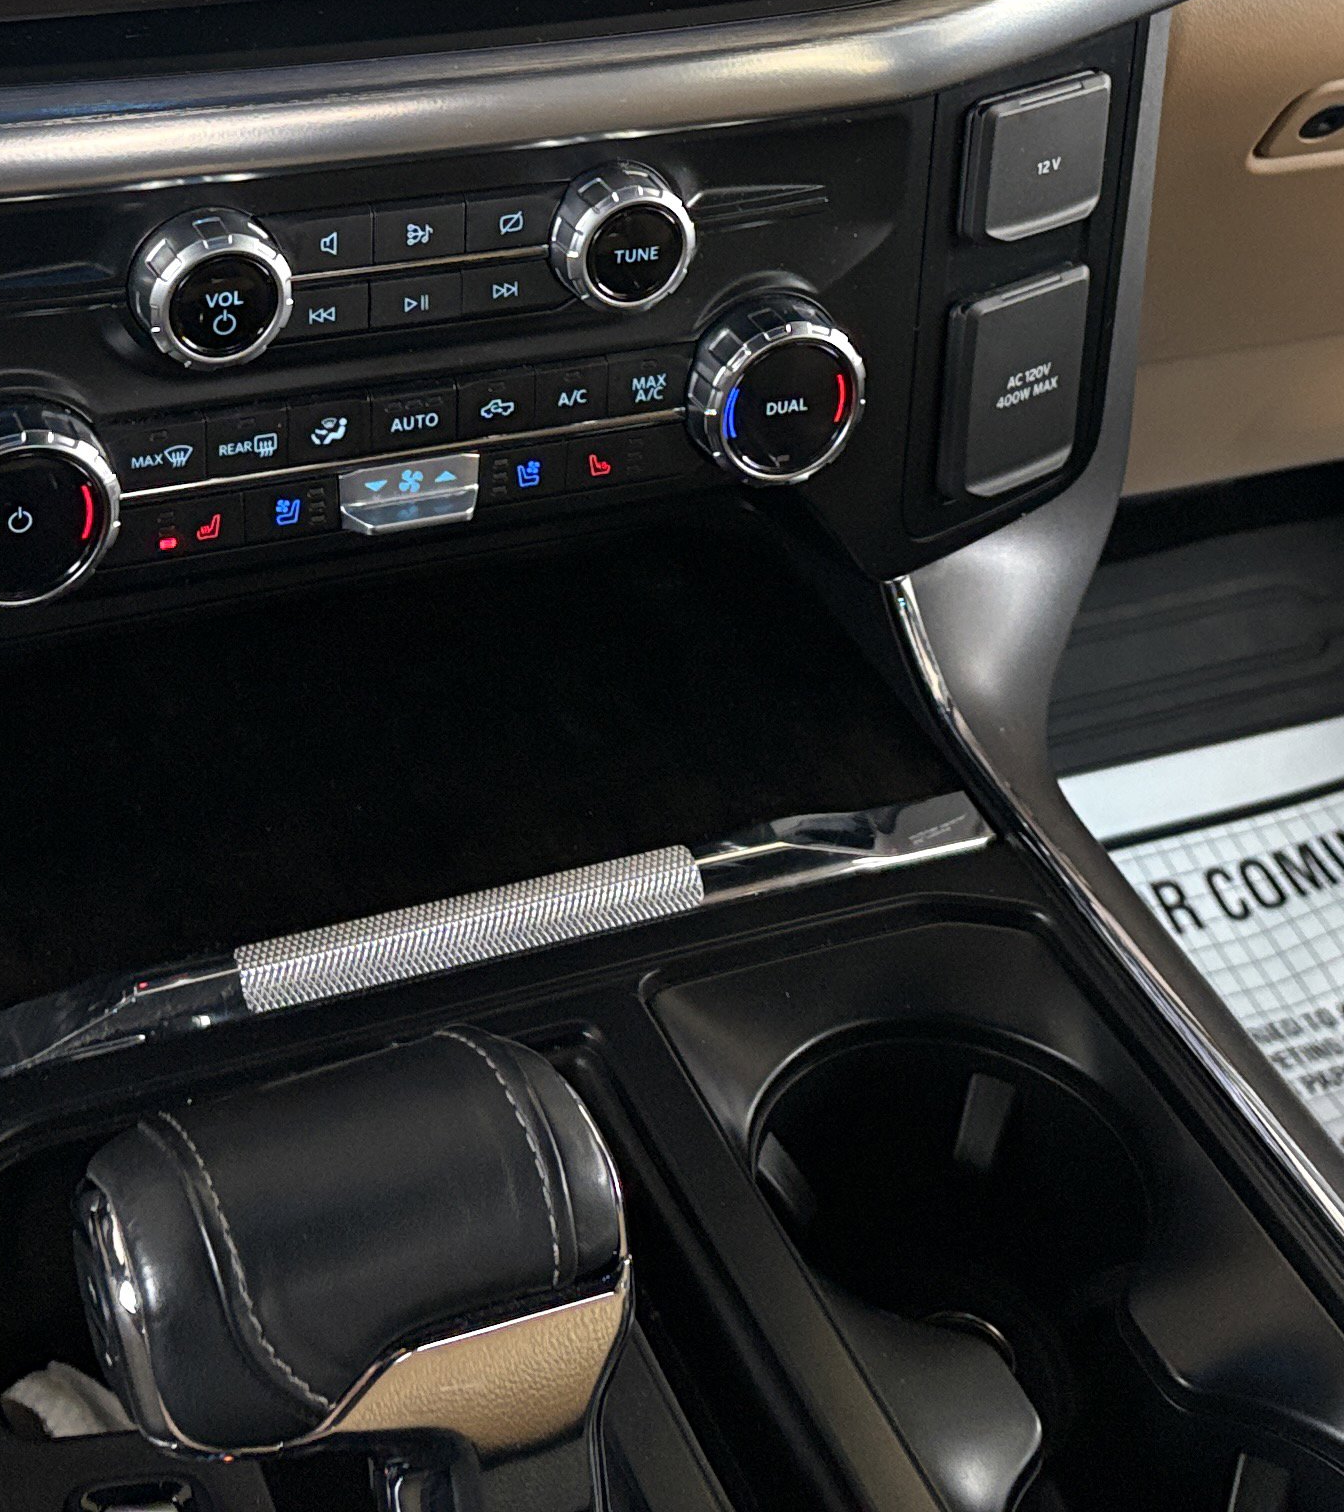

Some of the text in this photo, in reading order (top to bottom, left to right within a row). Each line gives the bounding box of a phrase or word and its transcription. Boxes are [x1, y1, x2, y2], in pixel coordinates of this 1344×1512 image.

[614, 245, 659, 264] TUNE
[205, 290, 244, 309] VOL
[631, 372, 667, 391] MAX
[1006, 361, 1052, 391] AC 120V
[557, 388, 588, 407] A/C
[634, 386, 664, 404] A/C
[995, 375, 1059, 410] 400W MAX
[765, 397, 808, 416] DUAL
[390, 412, 439, 433] AUTO
[218, 441, 253, 457] REAR
[130, 453, 164, 470] MAX
